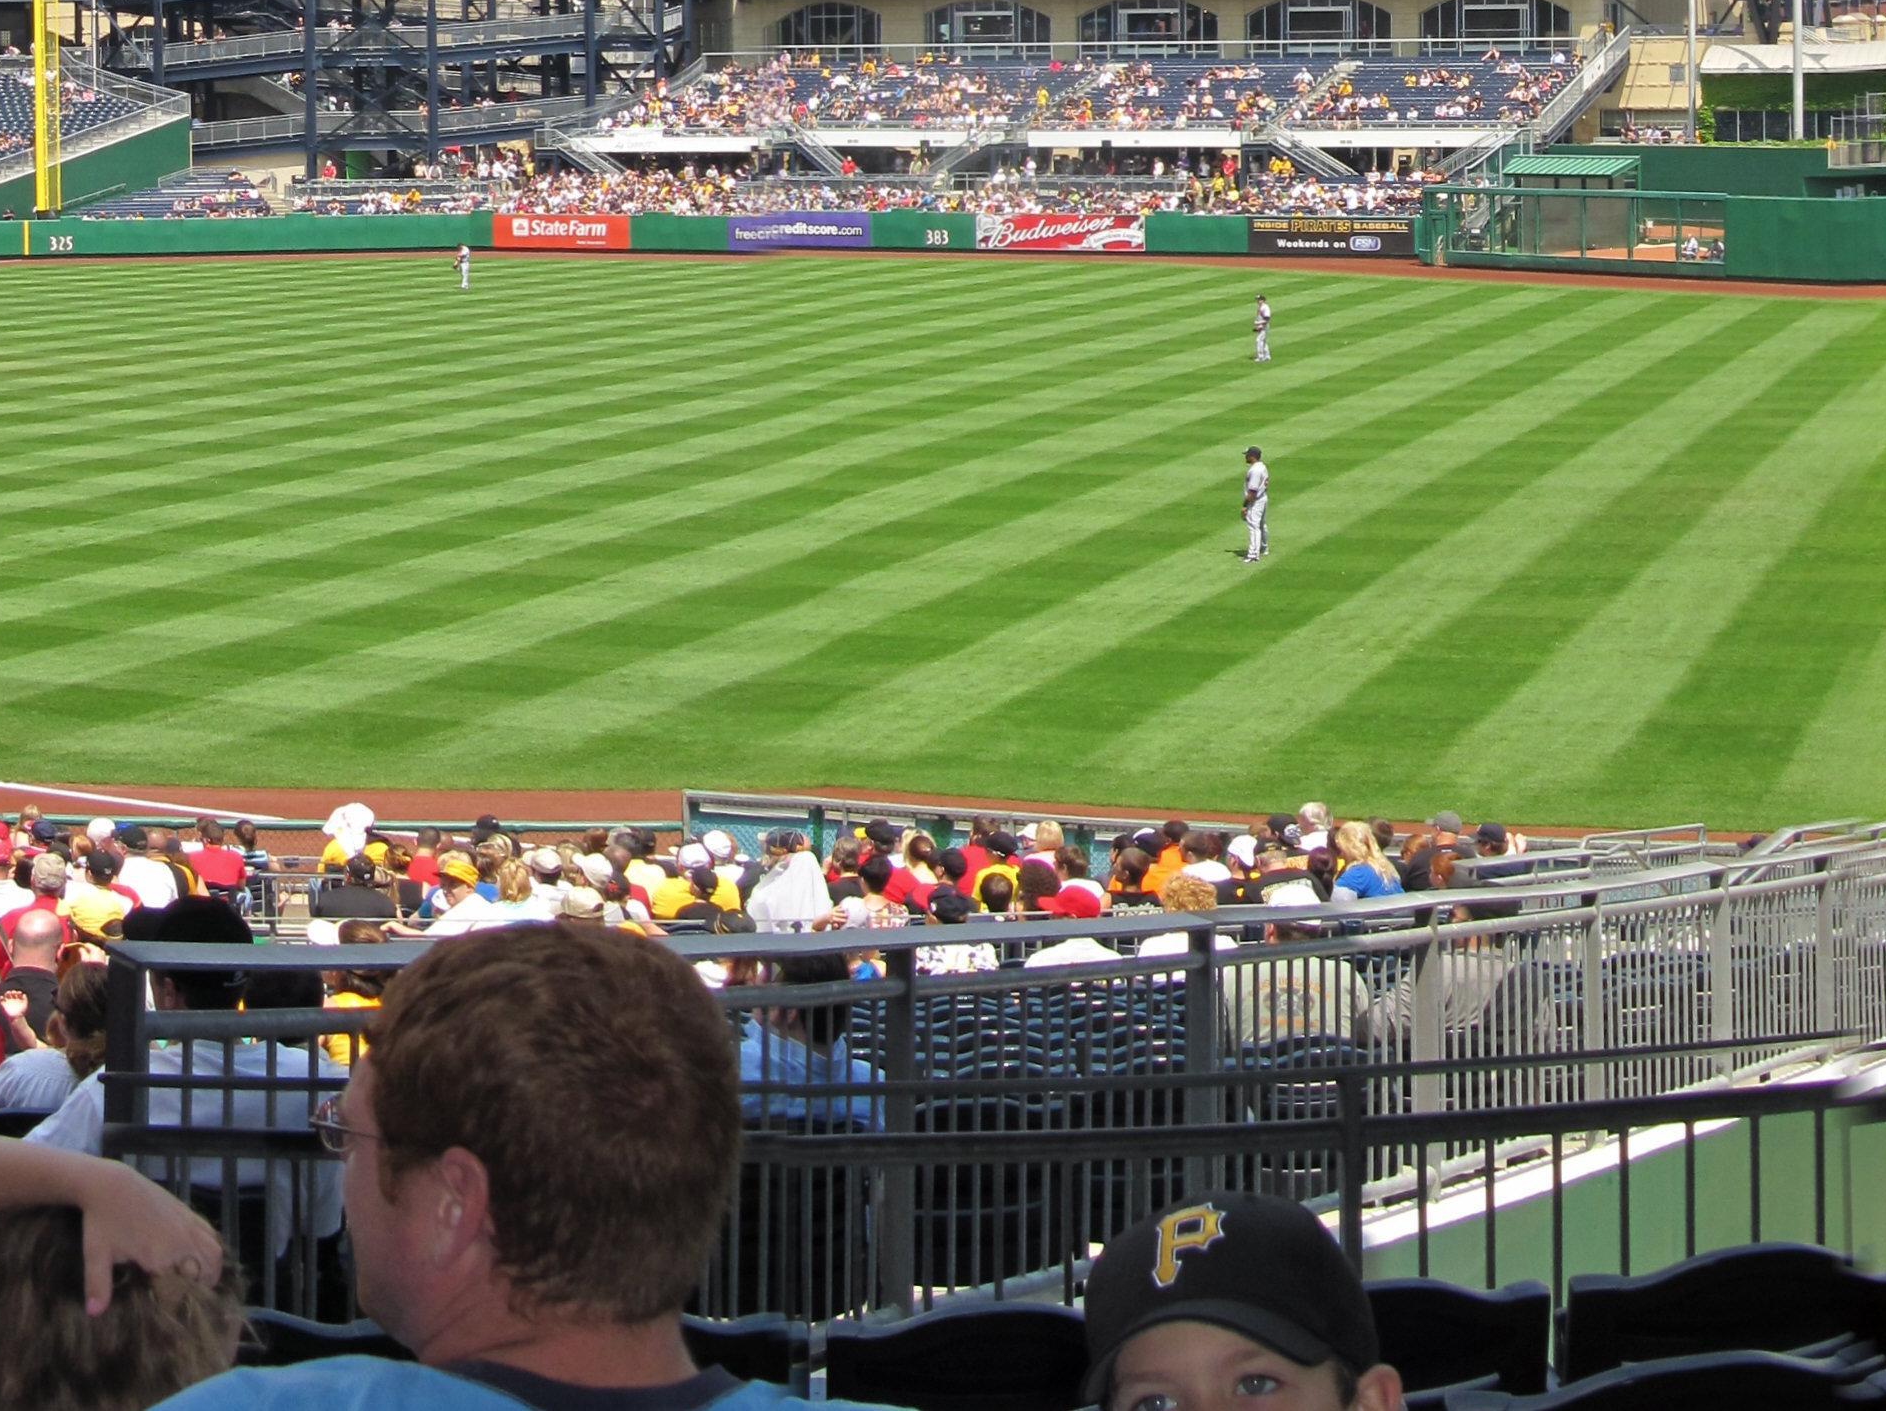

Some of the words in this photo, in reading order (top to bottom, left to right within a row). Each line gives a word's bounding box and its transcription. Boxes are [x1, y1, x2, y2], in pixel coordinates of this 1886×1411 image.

[986, 215, 1114, 248] Budweiser
[1253, 221, 1288, 229] INSIDE
[1290, 219, 1351, 233] PIRATES
[1353, 221, 1408, 230] BASEBALL
[49, 236, 73, 250] 325
[926, 229, 949, 245] 383
[1276, 239, 1329, 248] Weekends
[1333, 240, 1346, 248] on
[1152, 1201, 1227, 1288] P
